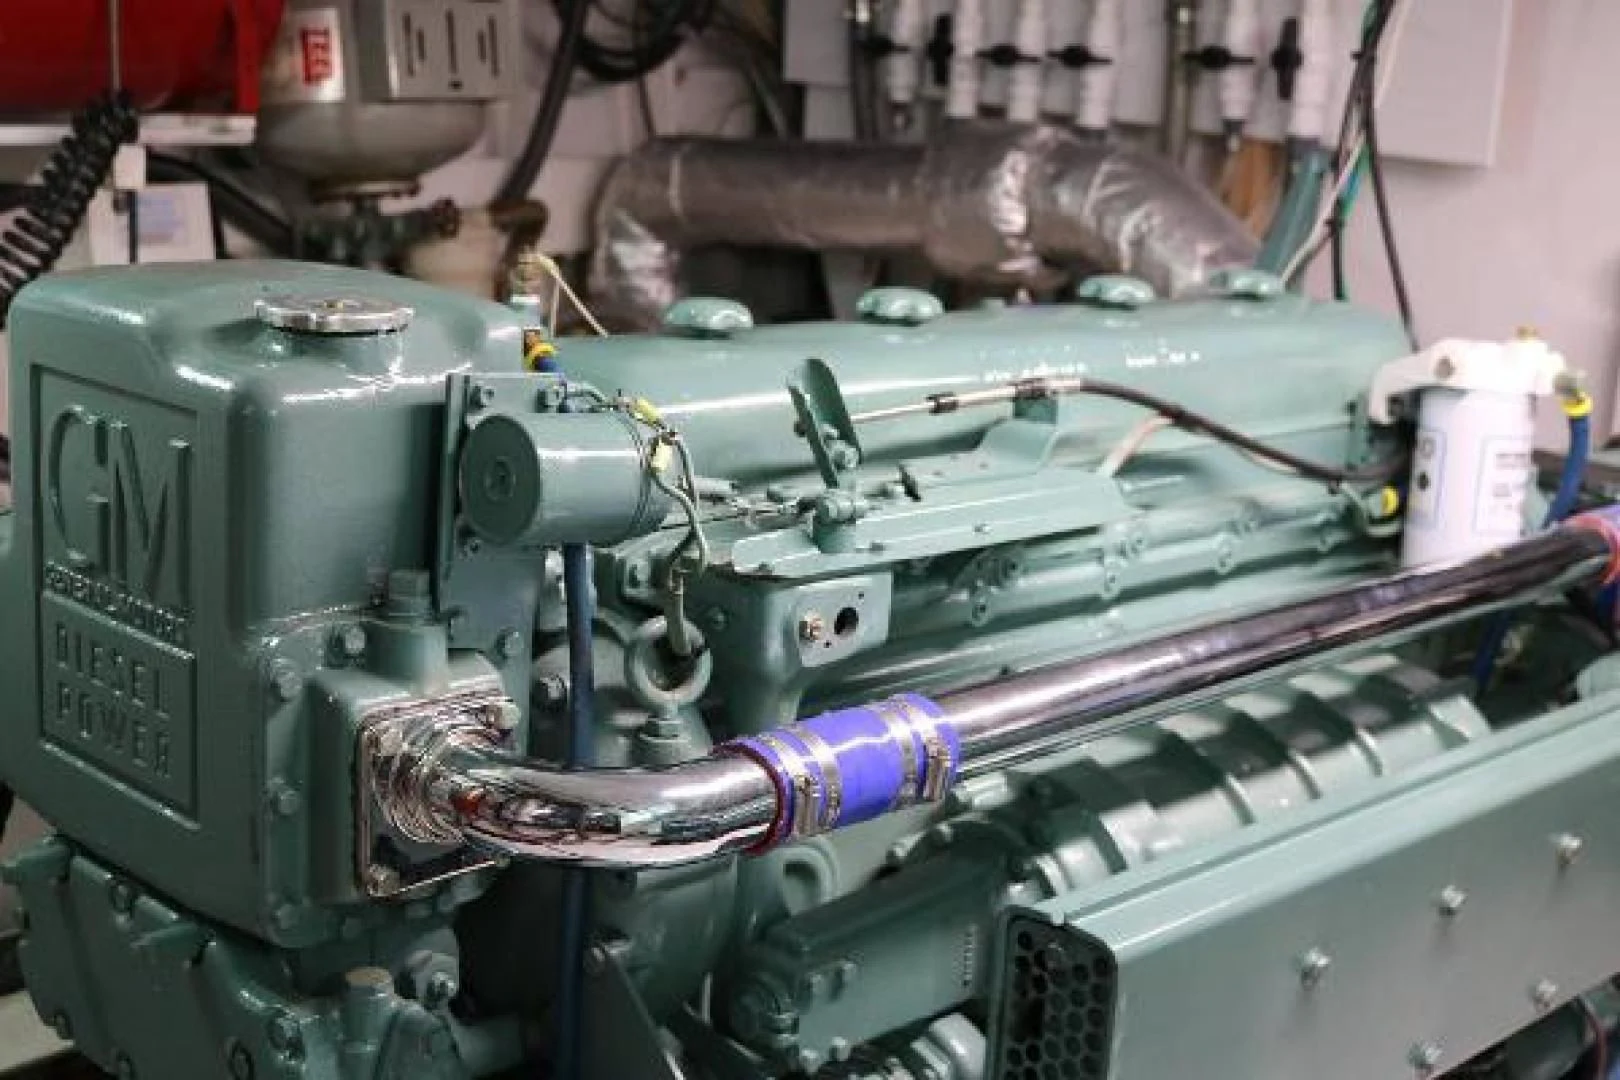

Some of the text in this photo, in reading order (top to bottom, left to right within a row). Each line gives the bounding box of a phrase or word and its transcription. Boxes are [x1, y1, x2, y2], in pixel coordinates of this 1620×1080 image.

[48, 404, 193, 612] GM
[55, 621, 171, 721] DIESEL
[56, 680, 172, 780] POWER
